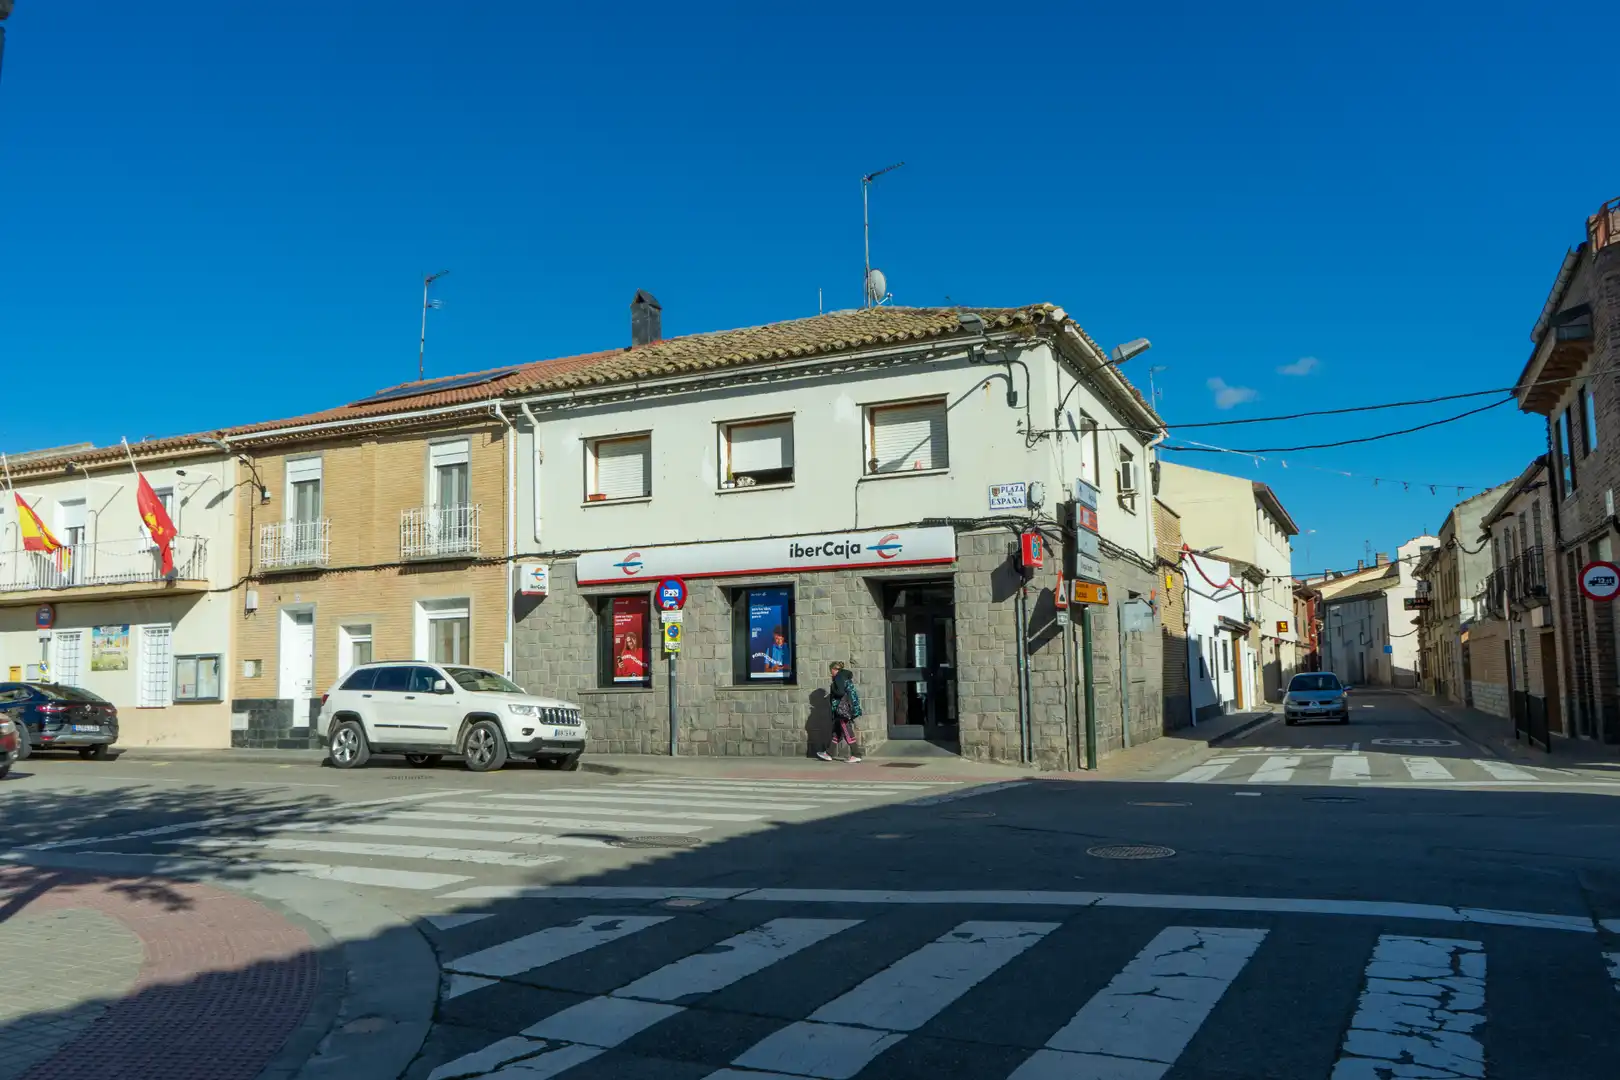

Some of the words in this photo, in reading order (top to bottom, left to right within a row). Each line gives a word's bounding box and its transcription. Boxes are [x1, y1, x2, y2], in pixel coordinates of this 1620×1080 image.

[1001, 485, 1024, 493] PLAZA
[991, 496, 1023, 505] ESPAÑA
[789, 540, 861, 559] iberCaja
